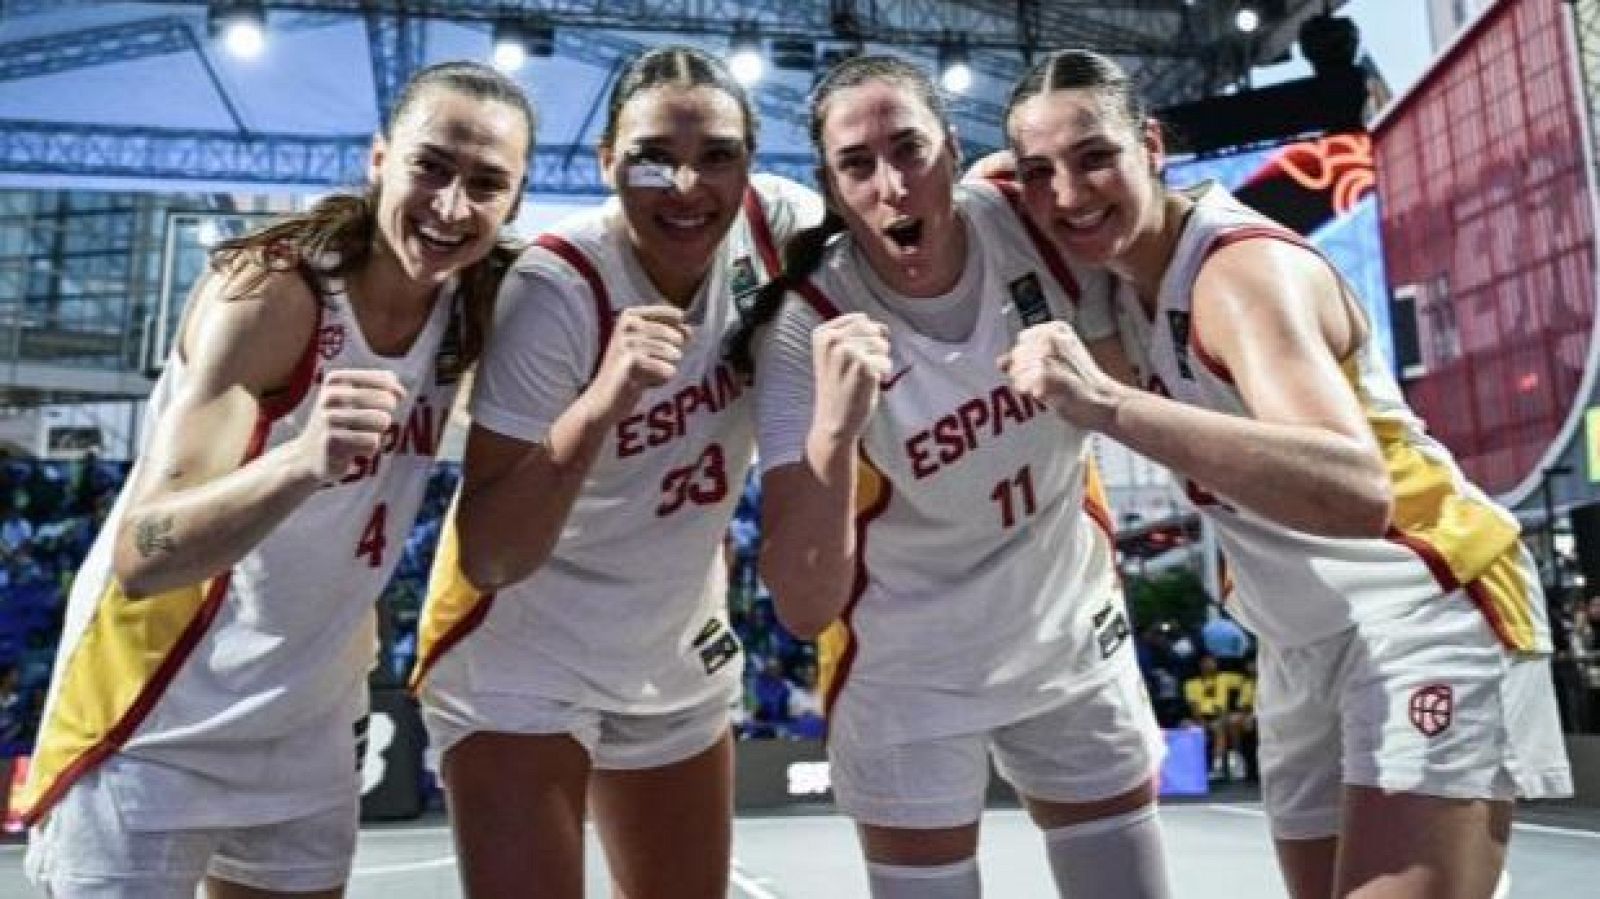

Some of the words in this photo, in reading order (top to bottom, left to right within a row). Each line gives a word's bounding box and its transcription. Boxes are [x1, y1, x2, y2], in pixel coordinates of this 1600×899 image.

[656, 442, 728, 518] 33
[990, 464, 1037, 530] 11
[354, 502, 387, 568] 4
